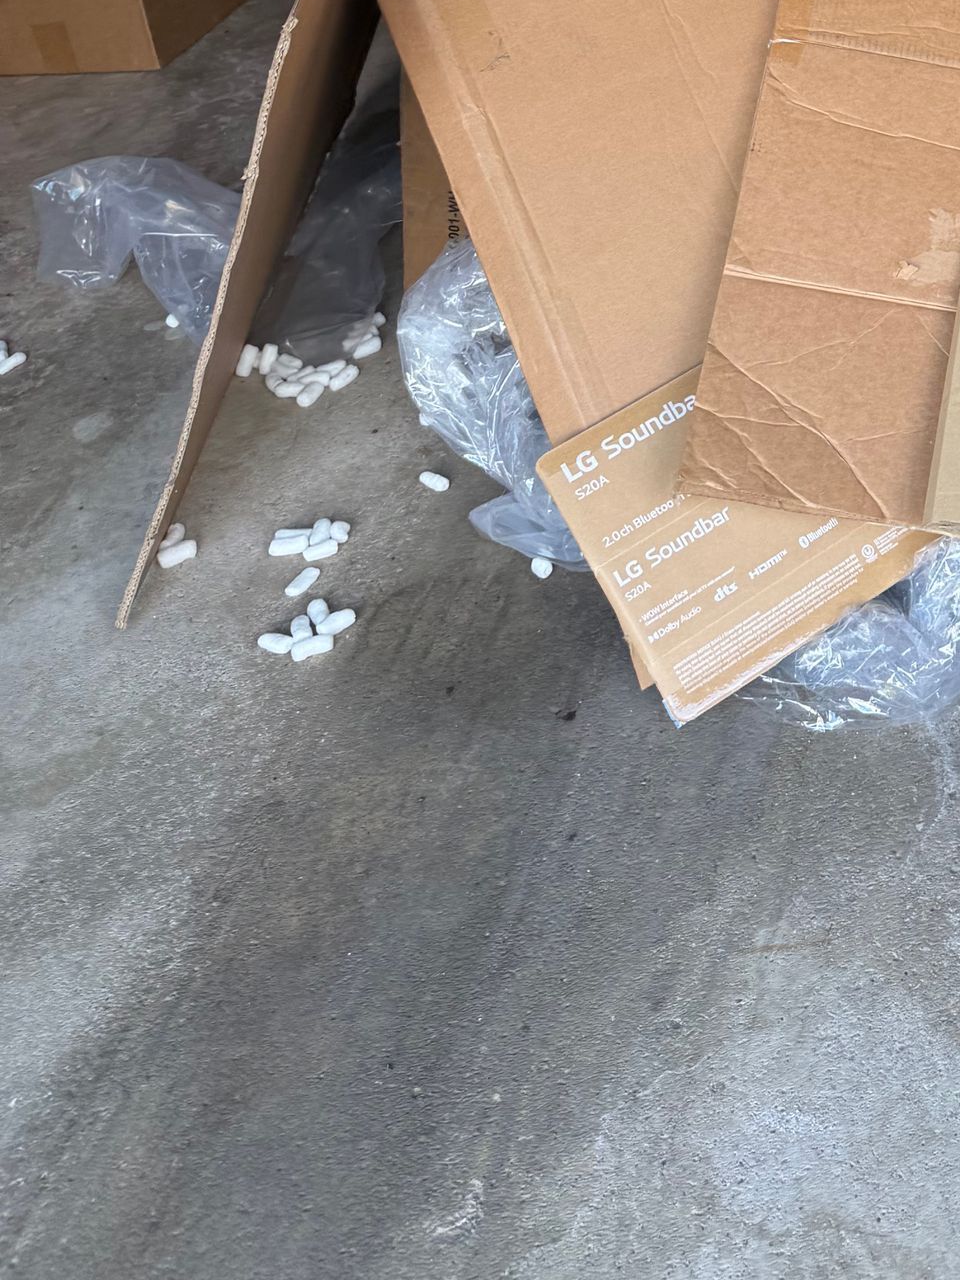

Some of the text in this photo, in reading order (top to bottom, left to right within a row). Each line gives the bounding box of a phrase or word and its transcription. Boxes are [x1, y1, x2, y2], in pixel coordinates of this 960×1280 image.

[560, 395, 697, 484] LG Soundba
[574, 475, 611, 501] S20A
[807, 517, 839, 543] Bluetooth
[612, 506, 731, 588] LG Soundbar
[624, 581, 652, 602] S20A
[640, 589, 689, 622] WOW Interface
[713, 582, 739, 602] dts
[657, 606, 702, 637] Dolby Audio
